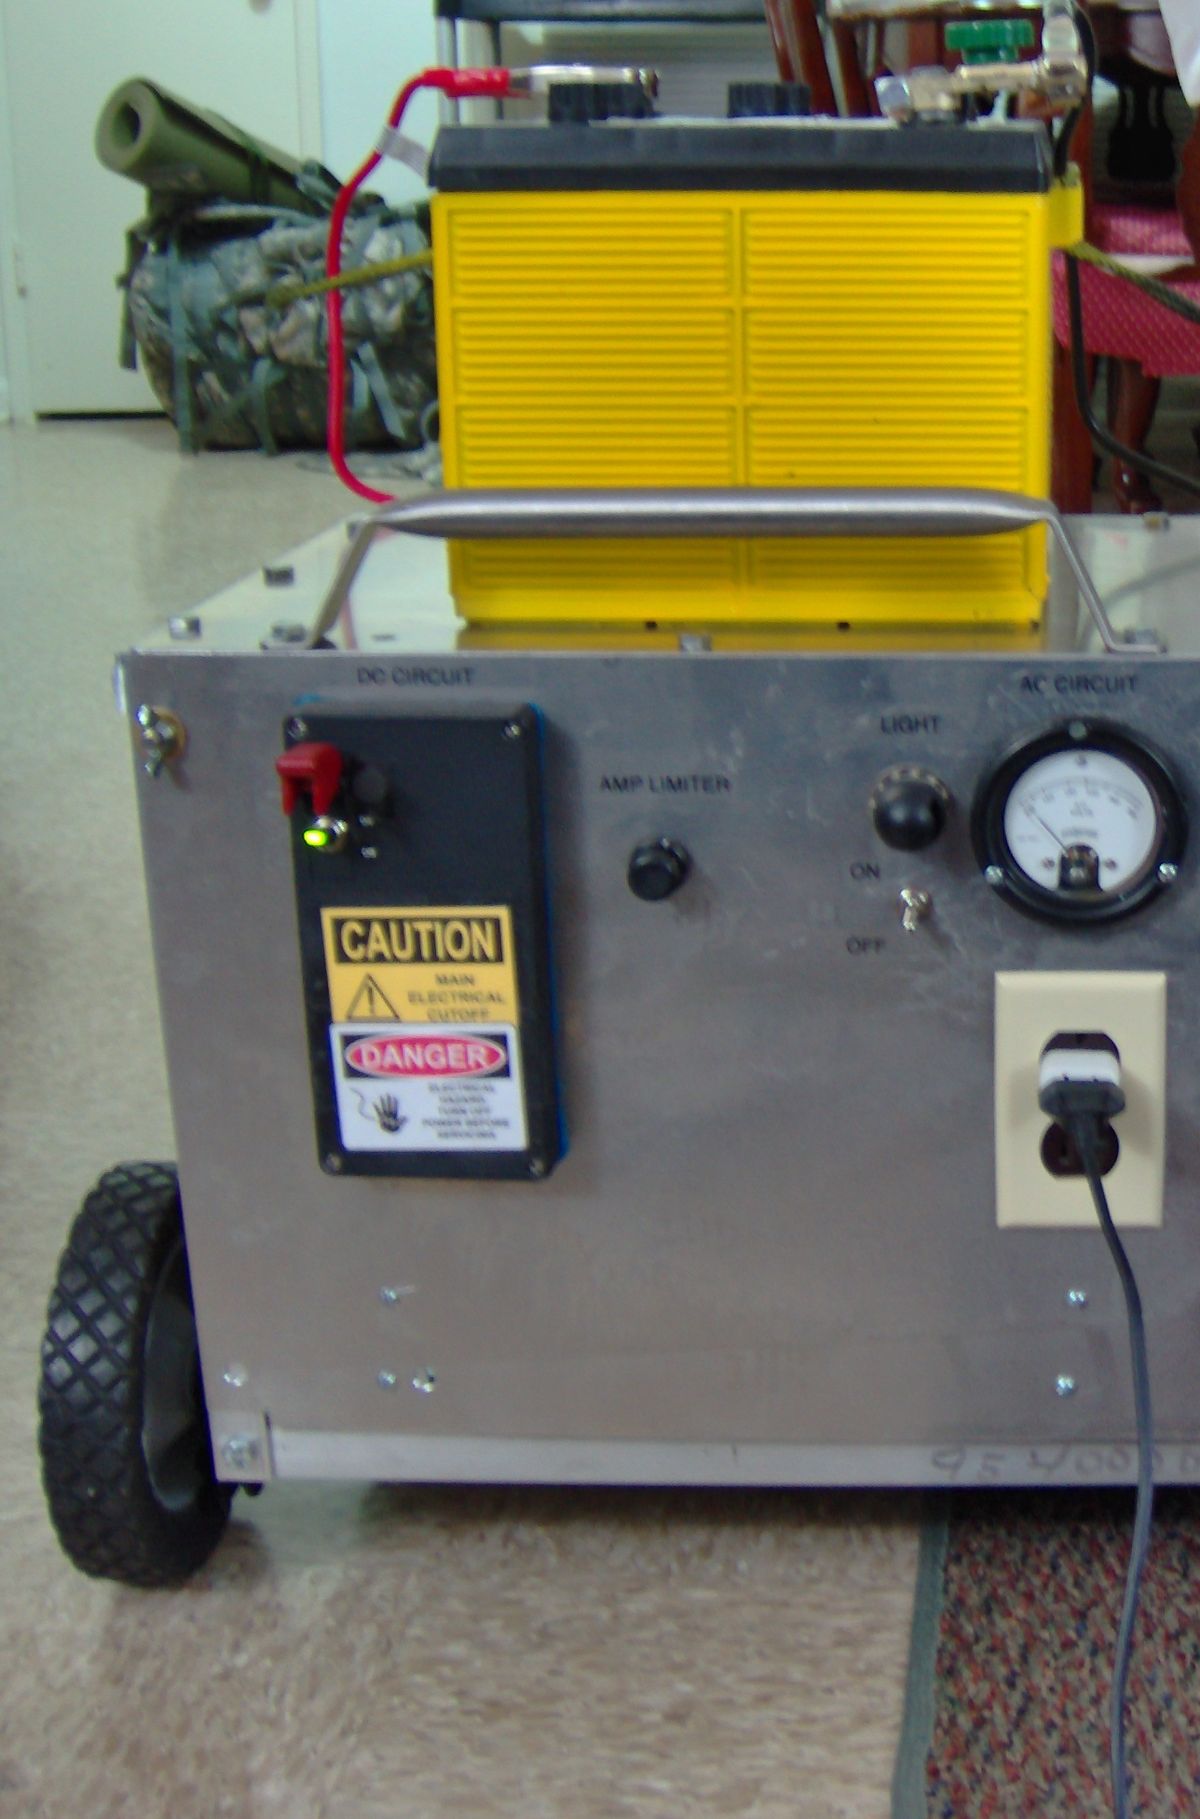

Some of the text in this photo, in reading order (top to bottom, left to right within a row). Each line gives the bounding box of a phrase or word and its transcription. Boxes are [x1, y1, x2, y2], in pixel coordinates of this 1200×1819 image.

[391, 666, 475, 686] CIRCUIT
[1021, 674, 1139, 694] AC CIRCUIT
[880, 715, 940, 735] LIGHT
[600, 774, 731, 794] AMP LIMITER
[850, 862, 880, 880] ON
[340, 918, 497, 963] CAUTION
[846, 936, 886, 955] OFF
[435, 973, 475, 986] MAIN
[407, 990, 503, 1005] ELECTRICAL
[427, 1007, 489, 1022] CUTOFF
[360, 1043, 488, 1069] DANGER
